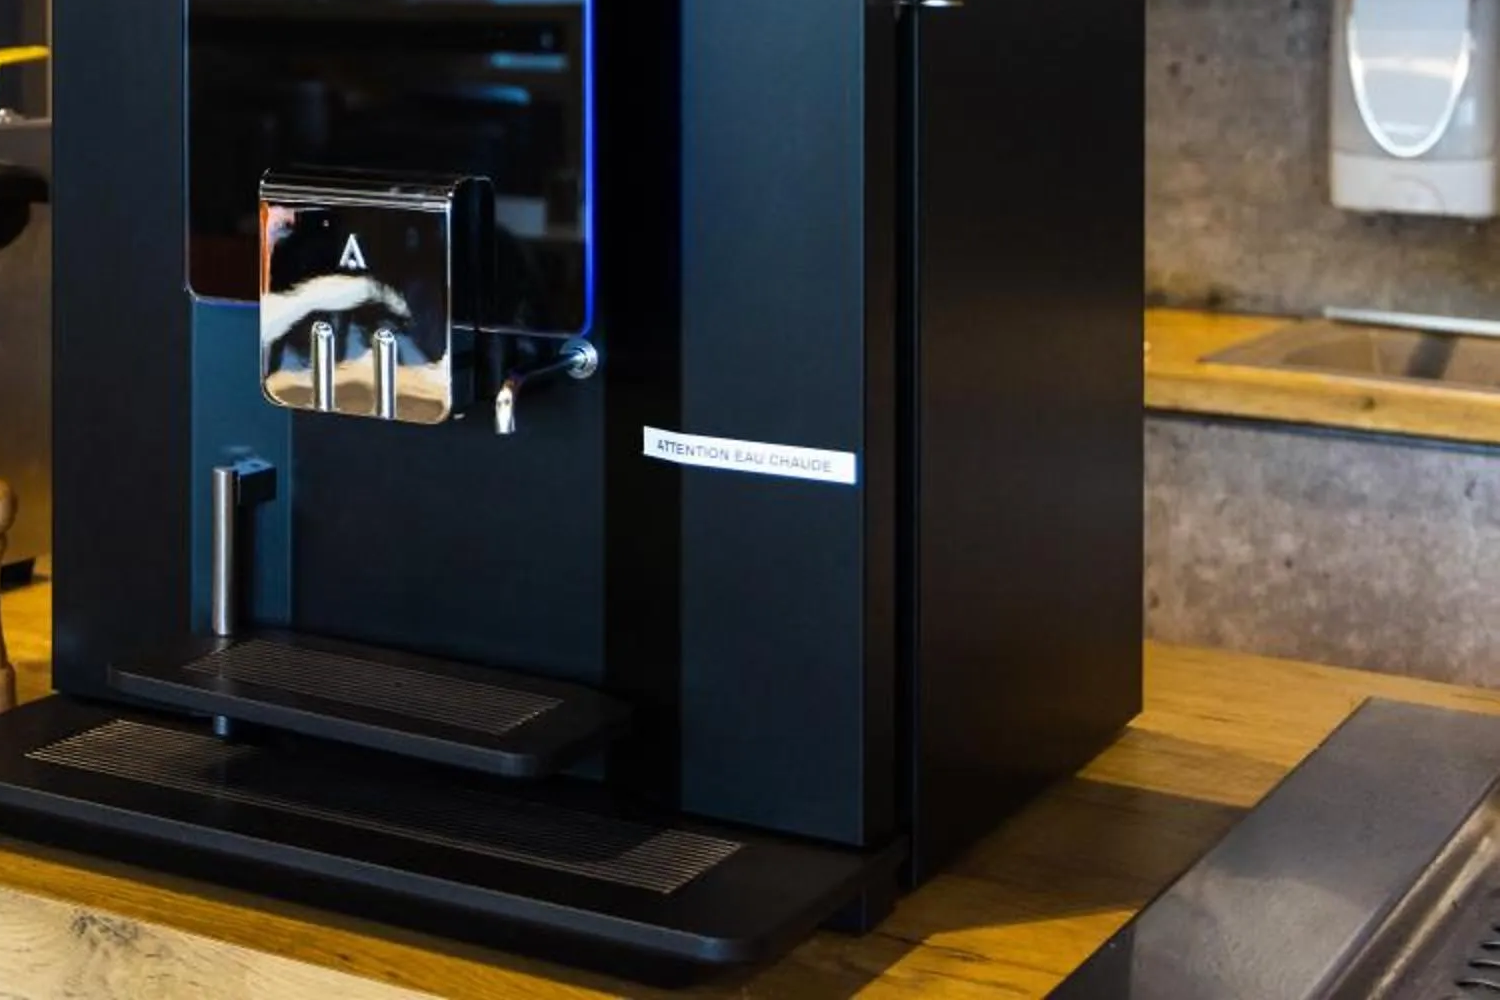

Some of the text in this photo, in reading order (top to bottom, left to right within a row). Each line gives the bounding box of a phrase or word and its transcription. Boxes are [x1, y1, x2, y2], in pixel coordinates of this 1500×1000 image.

[656, 438, 833, 474] ATTENTION EAU CHAUDE
